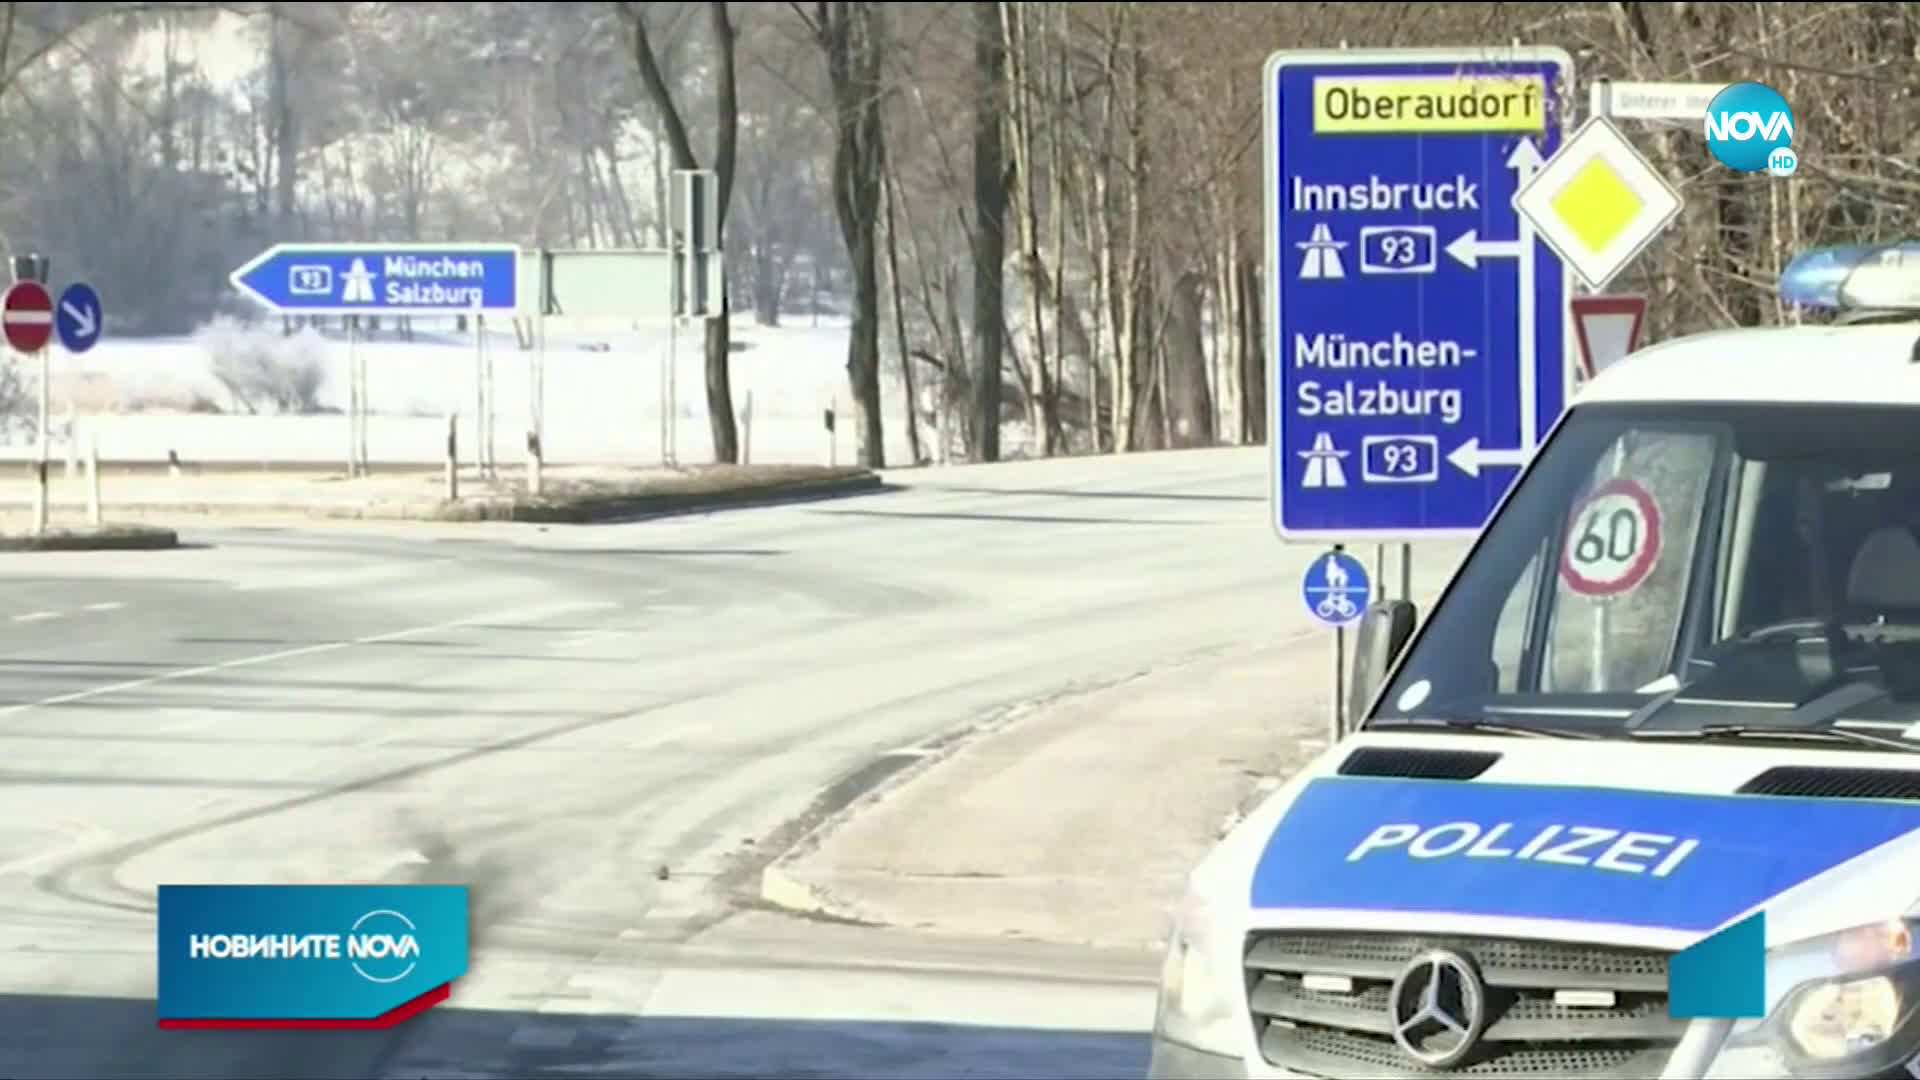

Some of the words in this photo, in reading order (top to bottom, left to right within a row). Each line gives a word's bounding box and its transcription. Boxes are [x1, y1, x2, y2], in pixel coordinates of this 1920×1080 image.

[1324, 85, 1536, 121] Oberaudorf
[1293, 174, 1479, 211] Innsbruck
[384, 255, 484, 279] München
[1380, 236, 1416, 263] 93
[300, 270, 322, 288] 93
[385, 282, 483, 308] Salzburg
[1295, 333, 1477, 368] München-
[1297, 382, 1463, 423] Salzburg
[1383, 445, 1419, 472] 93
[1573, 507, 1637, 565] 60
[1345, 822, 1700, 879] POLIZEI
